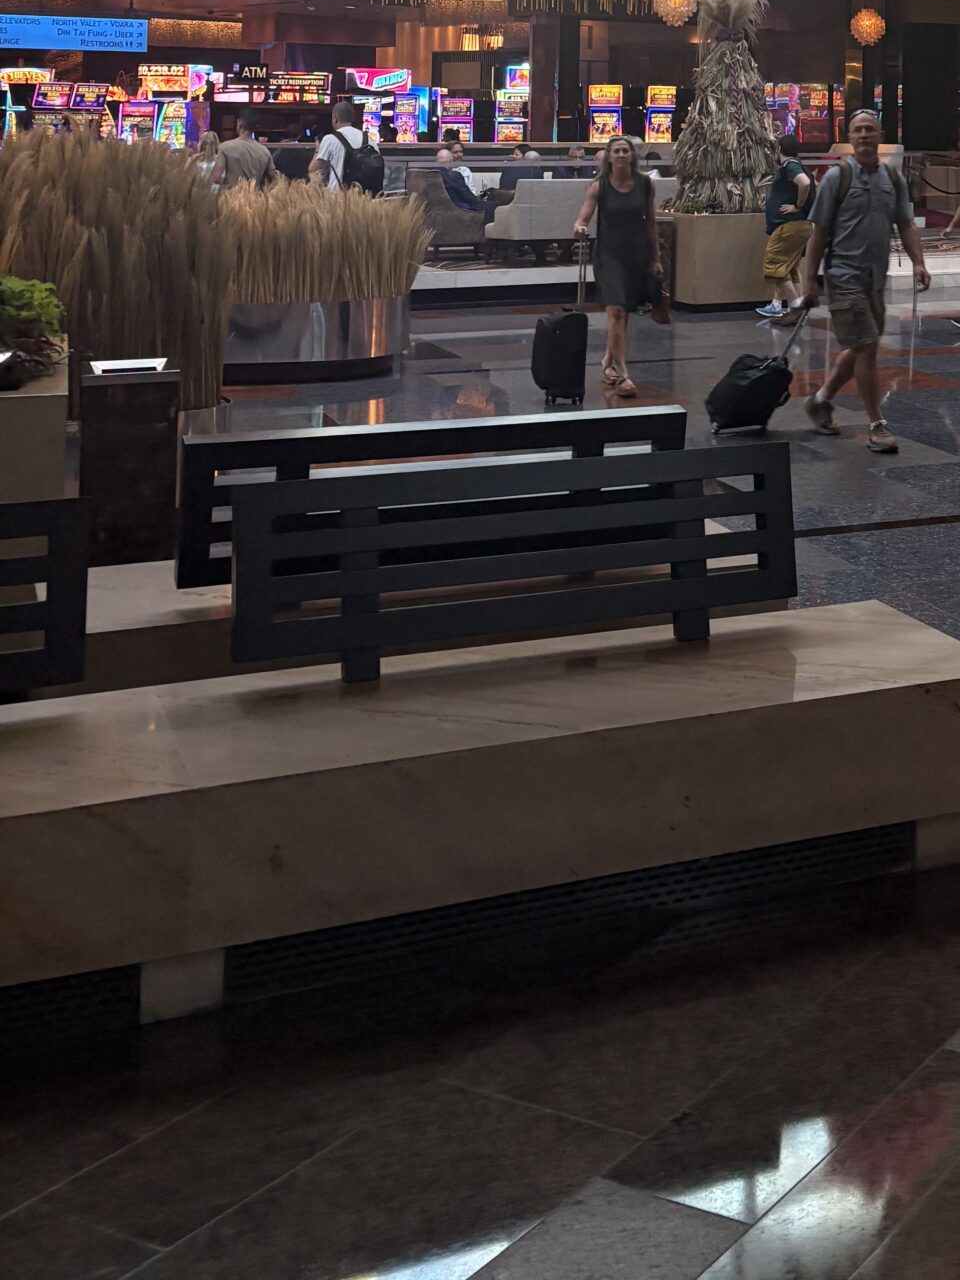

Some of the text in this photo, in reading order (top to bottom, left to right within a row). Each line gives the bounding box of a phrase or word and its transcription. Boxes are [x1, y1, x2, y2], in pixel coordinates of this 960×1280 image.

[52, 19, 78, 27] NORTH
[80, 19, 101, 28] VALET
[57, 28, 134, 39] DIN TAI FUNG UBER
[80, 39, 124, 49] RESTROOMS
[241, 66, 267, 79] ATM
[269, 78, 325, 87] TICKET REDEMPTION
